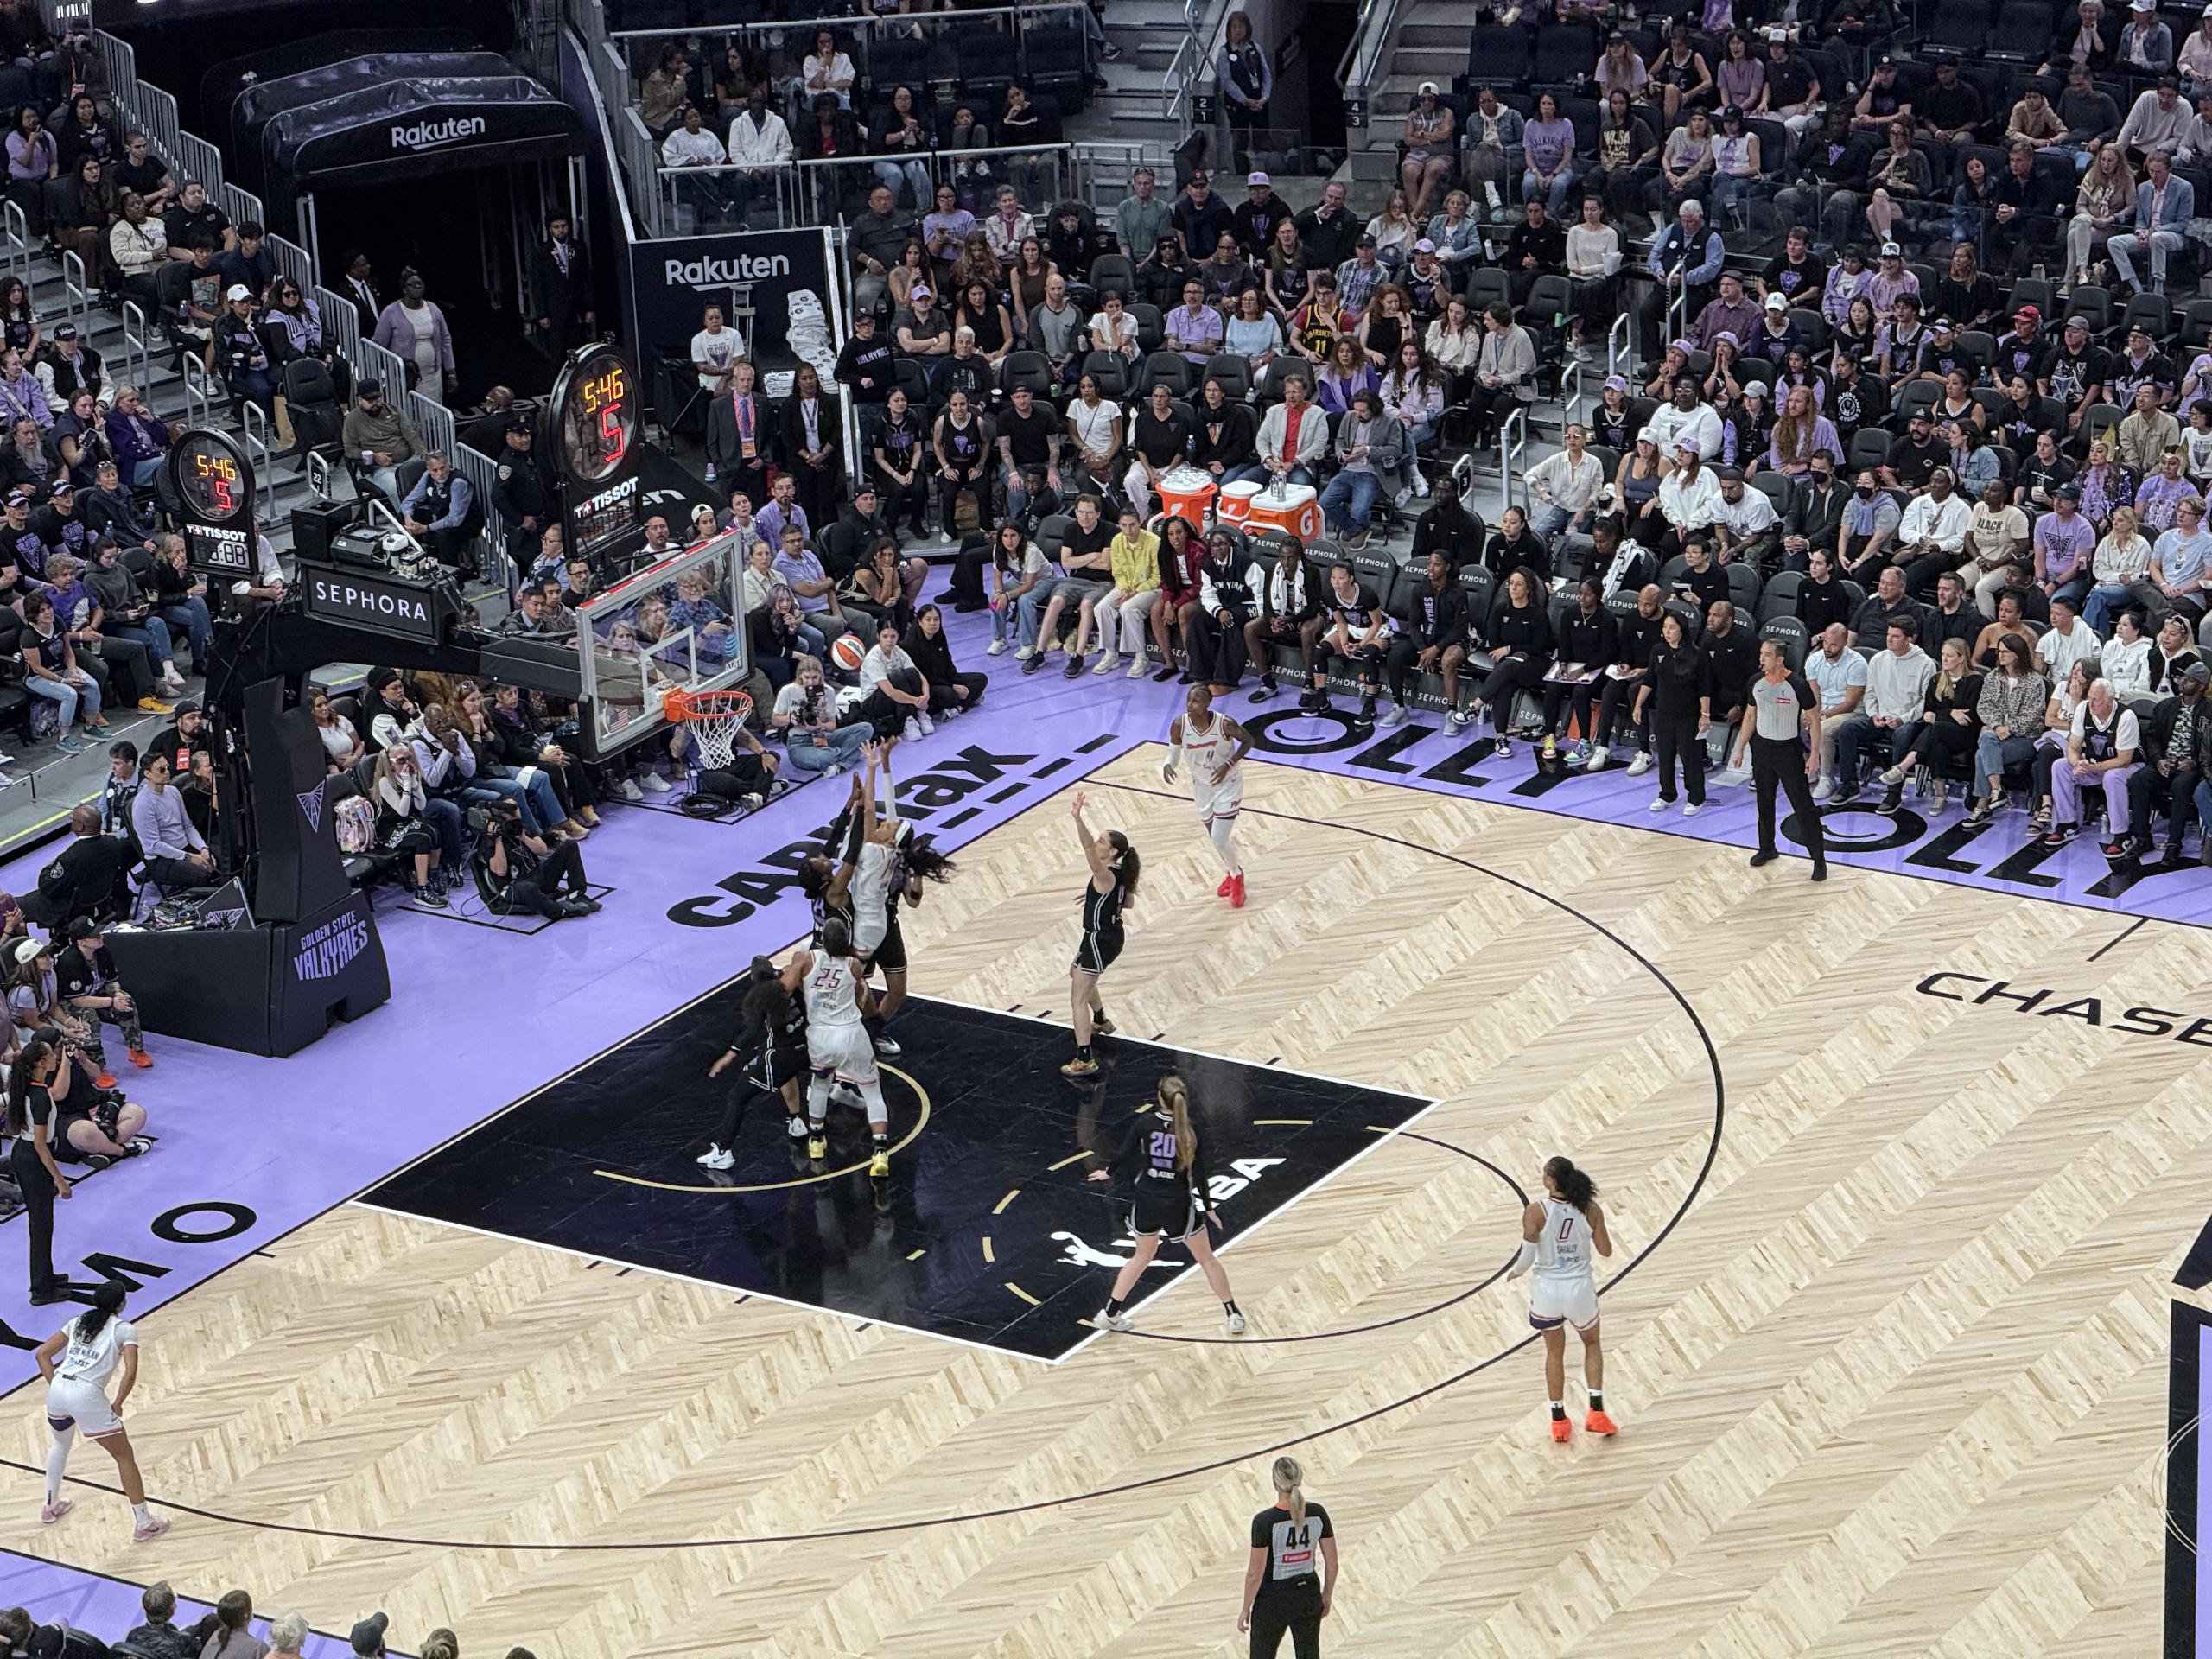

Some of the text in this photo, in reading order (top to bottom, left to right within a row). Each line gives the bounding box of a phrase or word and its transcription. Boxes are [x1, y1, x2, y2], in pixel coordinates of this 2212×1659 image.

[391, 116, 485, 148] Rakuten
[665, 254, 790, 286] Rakuten
[1315, 339, 1326, 354] 11
[583, 368, 625, 414] 5:46
[601, 403, 624, 462] 5
[196, 454, 237, 480] 5:46
[215, 480, 232, 510] 5
[591, 475, 639, 512] TISSOT
[201, 526, 247, 543] TISSOT
[1300, 509, 1313, 537] G
[1256, 539, 1281, 550] SEPHO
[1304, 548, 1338, 561] SEPHORA
[1356, 556, 1389, 569] SEPHORA
[1404, 564, 1429, 576] SEPHO
[1459, 573, 1488, 585] EPHORA
[315, 581, 428, 622] SEPHORA
[1555, 591, 1580, 602] SEPHO
[1607, 599, 1638, 610] SEPHOR
[1764, 624, 1802, 639] SEPHORA
[1271, 664, 1307, 680] SEPHOR
[1325, 674, 1363, 690] EPHORA
[1376, 683, 1413, 698] EPHRA
[1417, 691, 1460, 709] SEPHO
[1518, 709, 1562, 729] SEPHA
[1241, 708, 1631, 798] OLLY
[1780, 802, 2212, 899] OLLY
[300, 909, 357, 950] GOLDEN STATE
[294, 919, 369, 982] VALKYRIES
[811, 966, 844, 989] 25
[1149, 1130, 1176, 1159] 20
[1556, 1217, 1574, 1242] 0
[1285, 1524, 1311, 1550] 44
